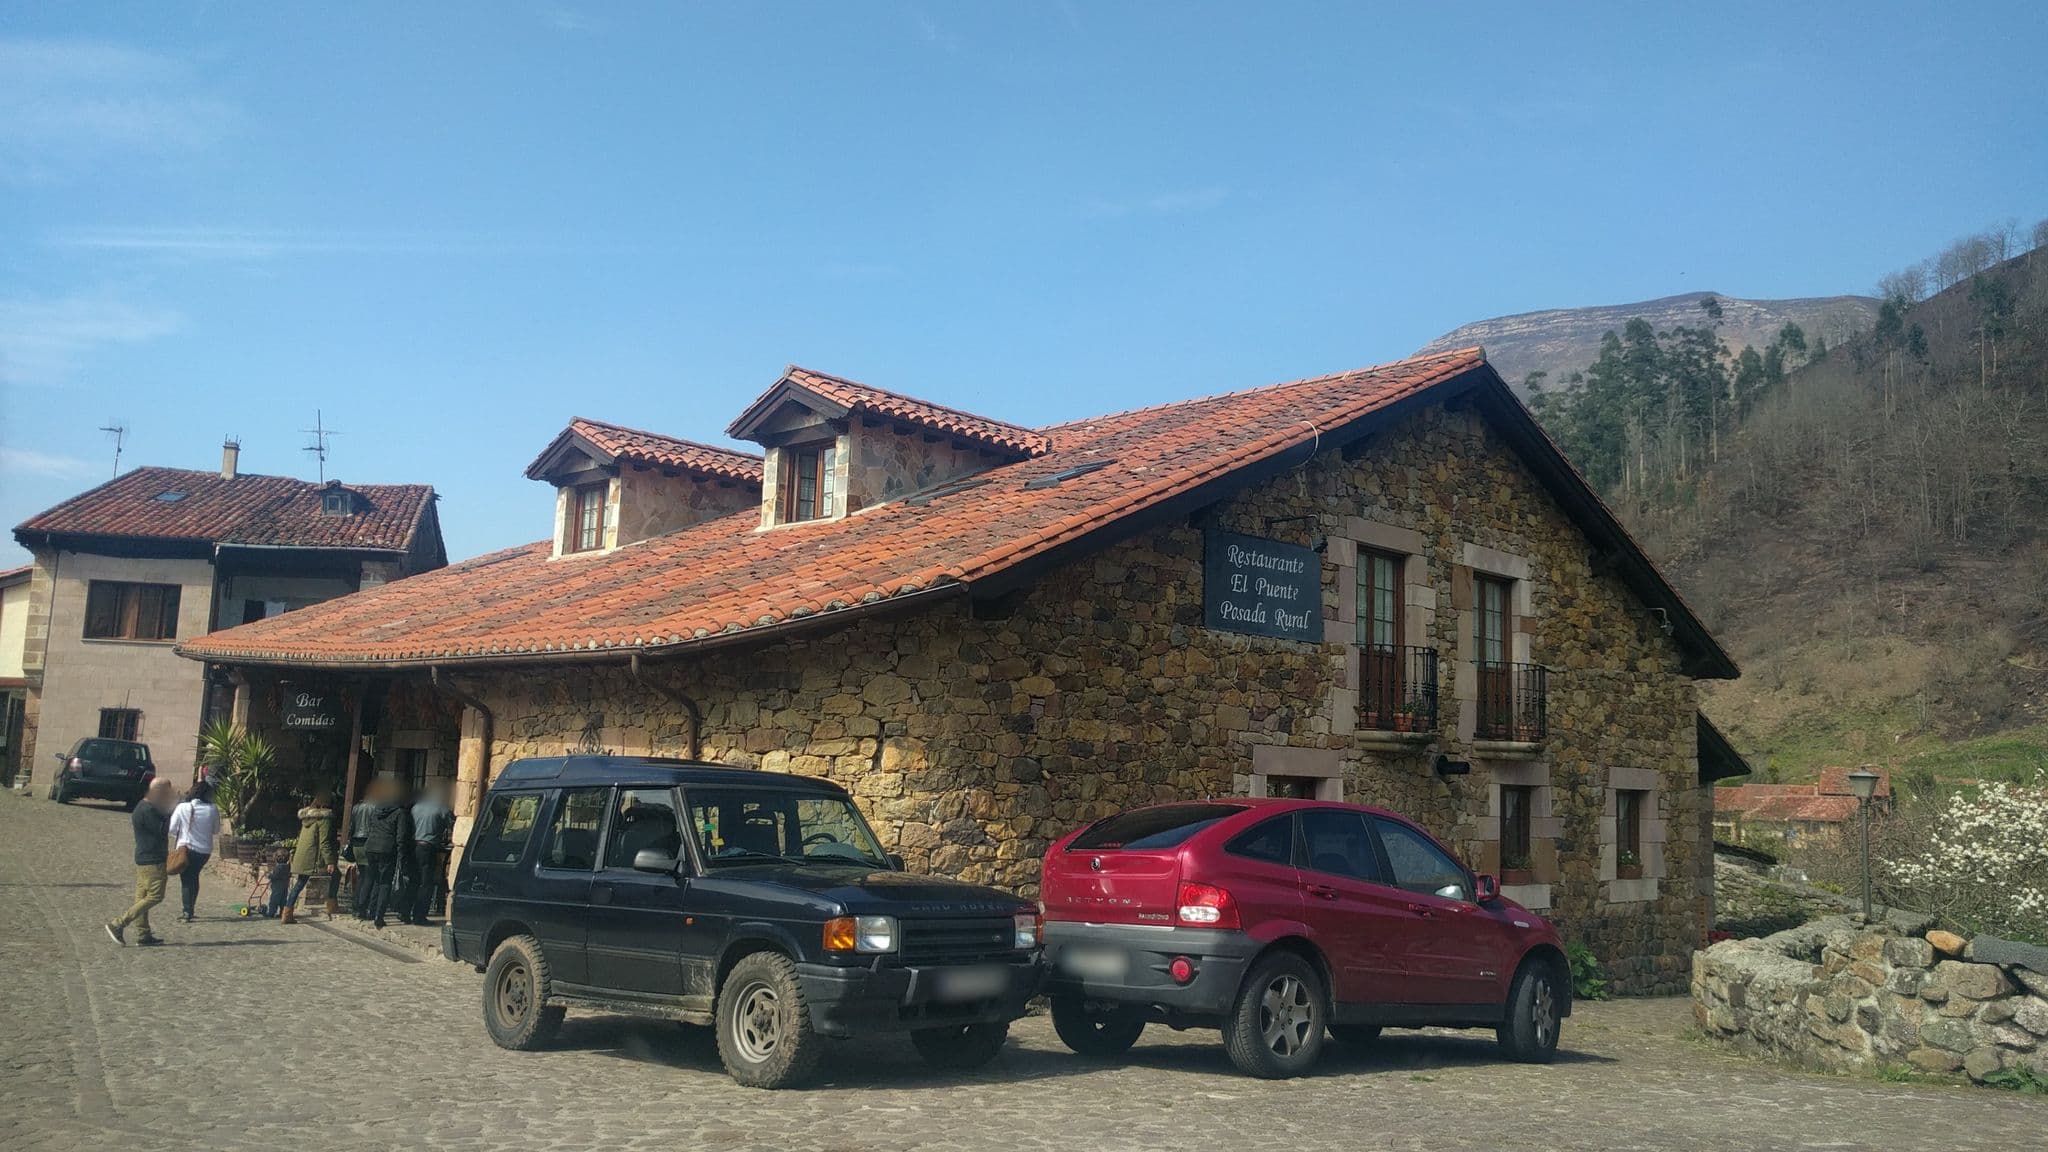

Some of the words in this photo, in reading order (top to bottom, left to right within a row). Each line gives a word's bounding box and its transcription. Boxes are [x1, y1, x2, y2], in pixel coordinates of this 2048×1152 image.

[1227, 544, 1304, 574] Restaurante
[1230, 573, 1248, 593] El
[1255, 577, 1299, 601] Puente
[1220, 600, 1266, 624] Posada
[1275, 608, 1311, 632] Rural
[296, 692, 323, 707] Bar
[286, 713, 336, 726] Comidas
